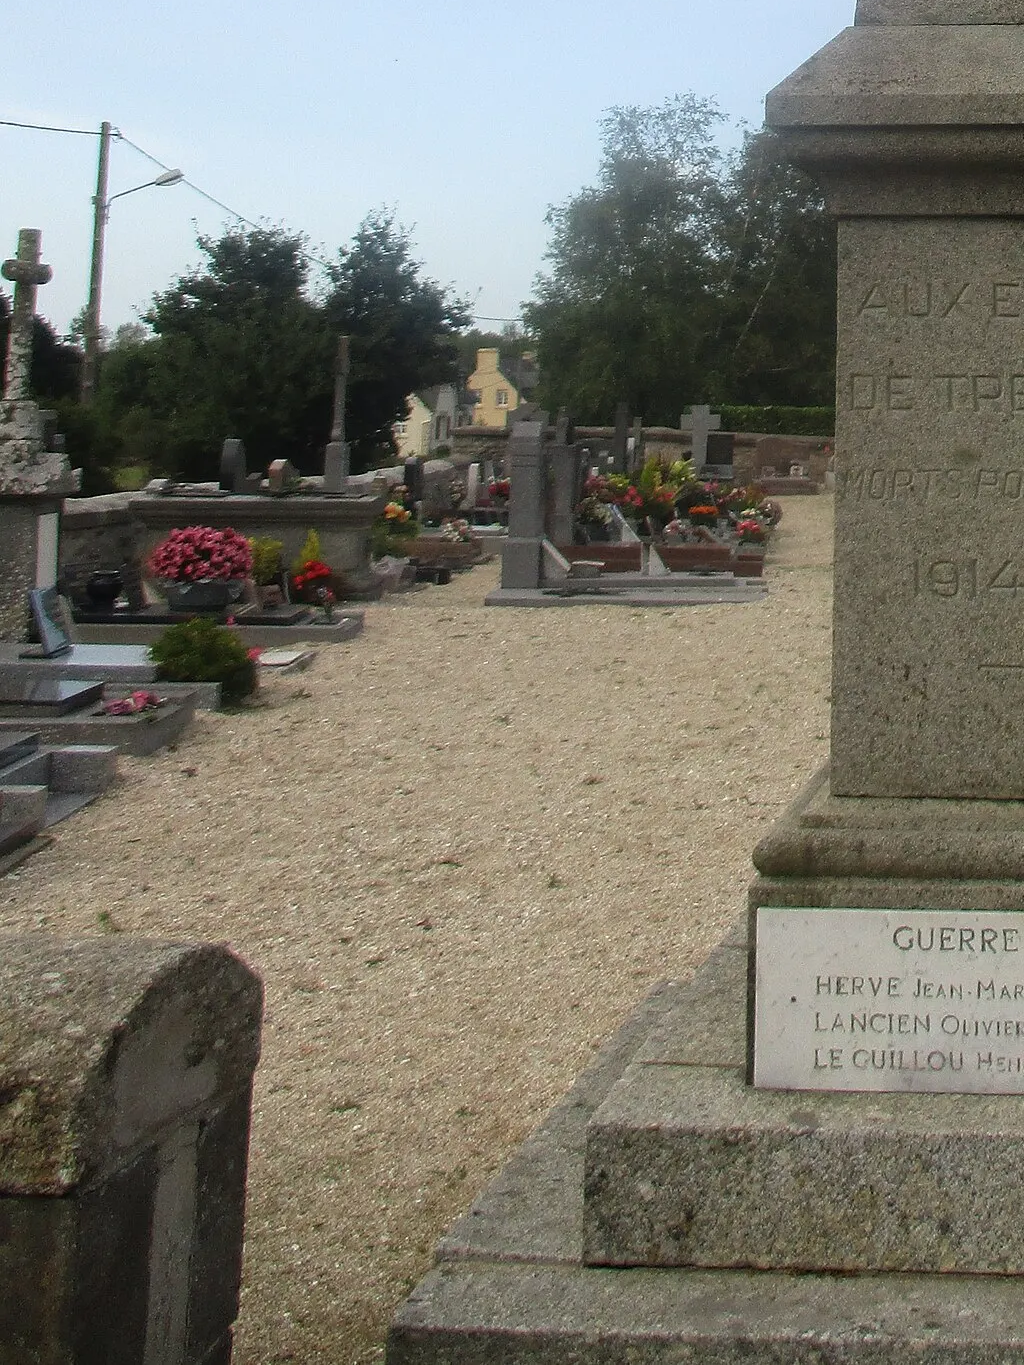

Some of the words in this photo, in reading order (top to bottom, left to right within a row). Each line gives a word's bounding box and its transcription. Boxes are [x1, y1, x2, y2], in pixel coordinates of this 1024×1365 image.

[856, 282, 972, 318] AUX
[850, 374, 914, 411] DE
[843, 468, 963, 502] MORTS
[892, 925, 1020, 954] GUERRE
[815, 975, 901, 998] HERVE
[815, 1011, 931, 1034] LANCIEN
[814, 1048, 843, 1071] LE
